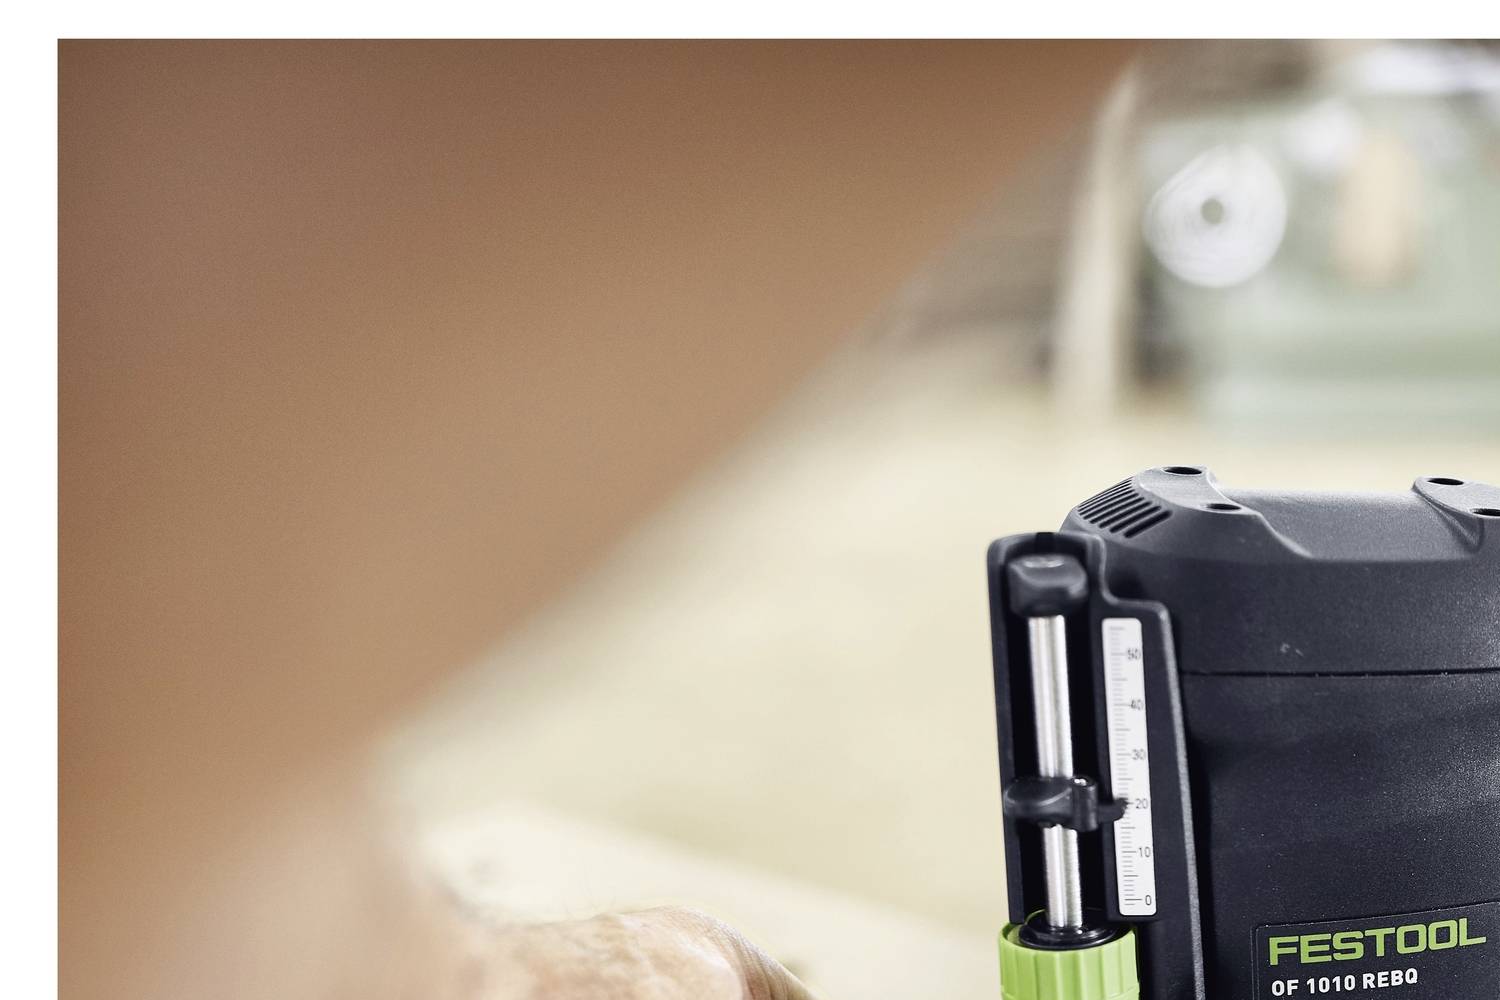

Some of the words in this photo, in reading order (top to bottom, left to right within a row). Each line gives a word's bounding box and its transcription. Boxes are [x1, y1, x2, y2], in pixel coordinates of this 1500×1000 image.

[1130, 699, 1144, 710] 40
[1132, 749, 1146, 760] 30
[1135, 798, 1148, 809] 20
[1138, 846, 1151, 857] 10
[1145, 894, 1152, 906] 0
[1269, 917, 1487, 966] FESTOOL
[1271, 979, 1299, 997] OF
[1306, 974, 1356, 994] 1010
[1362, 967, 1418, 990] REBQ
